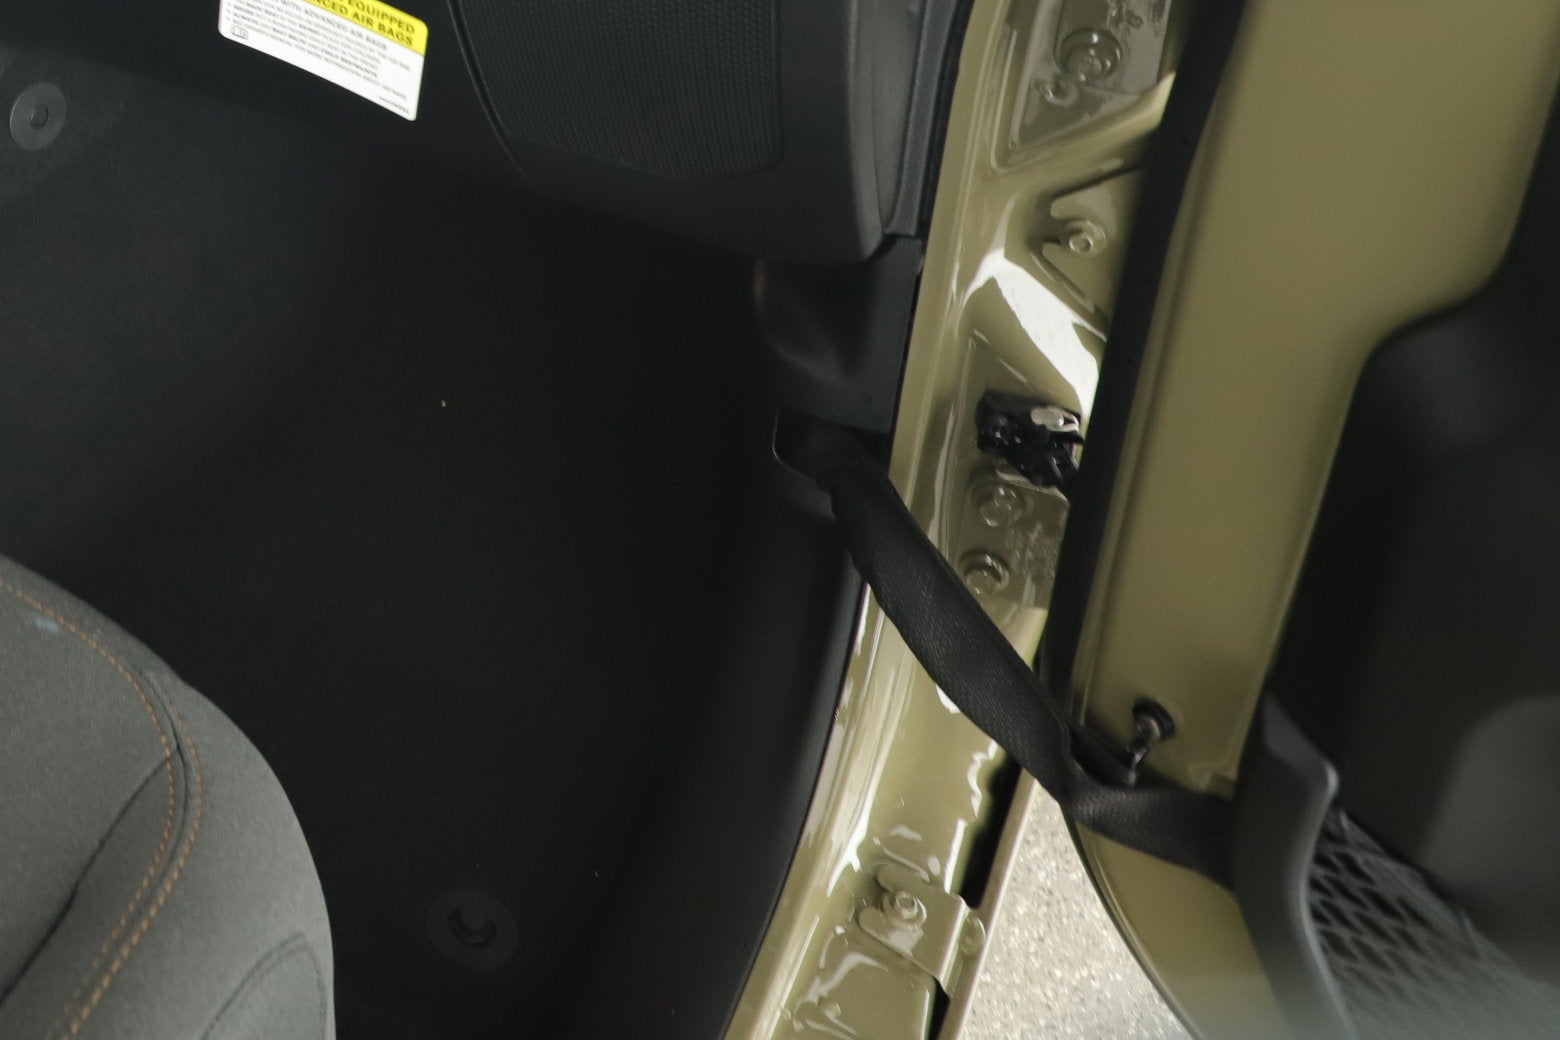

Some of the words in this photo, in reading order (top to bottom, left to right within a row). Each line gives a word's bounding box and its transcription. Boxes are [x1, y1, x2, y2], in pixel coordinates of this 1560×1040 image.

[304, 8, 347, 31] ADVANCED
[351, 28, 364, 39] AIR
[353, 11, 374, 27] AIR
[378, 23, 413, 46] BAGS
